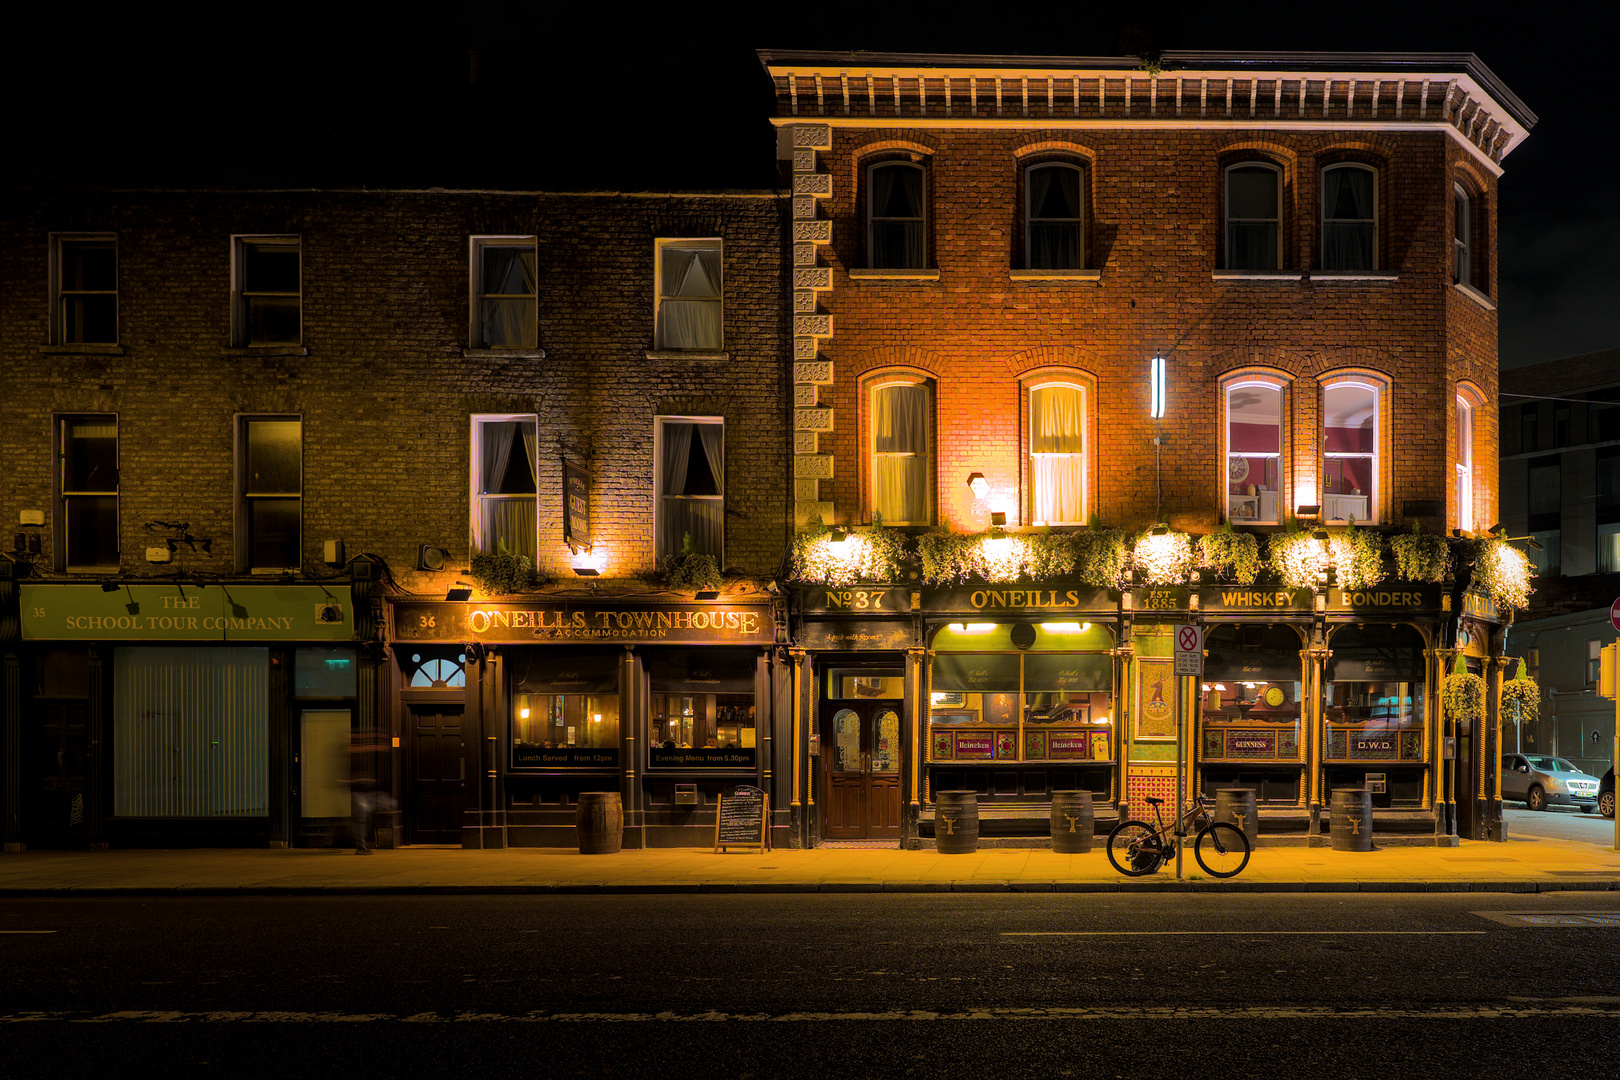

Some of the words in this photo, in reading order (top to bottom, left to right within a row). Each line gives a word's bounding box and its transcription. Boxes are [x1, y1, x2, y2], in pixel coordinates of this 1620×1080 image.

[570, 494, 586, 515] GUEST
[855, 591, 886, 609] 37
[970, 589, 1080, 609] O'NEILLS
[1149, 590, 1171, 599] EST
[1221, 591, 1297, 607] WHISKEY
[1341, 591, 1423, 607] BONDERS
[159, 595, 201, 609] THE
[1143, 598, 1177, 609] 1885
[32, 607, 46, 618] 35
[66, 616, 143, 630] SCHOOL
[146, 616, 199, 630] TOUR
[202, 616, 294, 630] COMPANY
[419, 615, 436, 628] 36
[468, 610, 587, 633] O'NEILLS
[595, 611, 760, 634] TOWNHOUSE
[555, 629, 666, 637] ACCOMMODATION
[959, 741, 990, 749] Heineken
[1052, 741, 1083, 749] Heineken
[1358, 741, 1393, 749] D.W.D.
[518, 754, 541, 762] Lunch
[542, 754, 568, 762] Served
[573, 754, 591, 762] from
[593, 754, 613, 763] 12pm
[655, 754, 684, 763] Evening
[685, 754, 705, 762] Menu
[706, 754, 723, 762] from
[724, 754, 750, 763] 5.30pm
